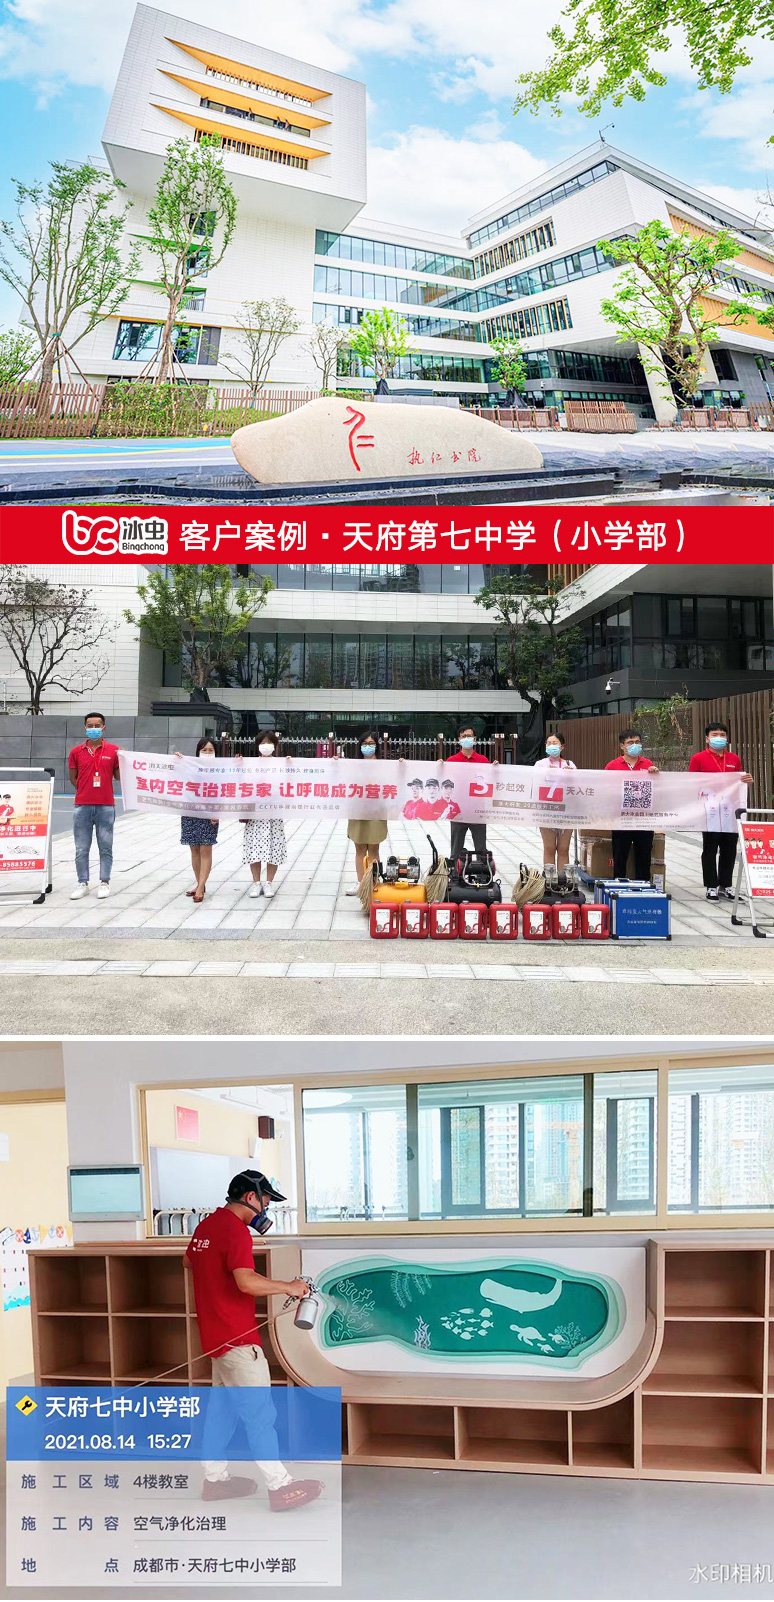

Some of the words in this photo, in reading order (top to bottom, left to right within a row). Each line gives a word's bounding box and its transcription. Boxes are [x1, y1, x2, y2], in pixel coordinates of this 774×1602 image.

[406, 447, 482, 467] 执仁书院
[135, 775, 273, 798] 室内空气治理专家
[278, 782, 399, 800] 让呼吸成为营养
[495, 782, 526, 793] 秒起效
[544, 775, 559, 799] 7
[565, 786, 595, 797] 天入住
